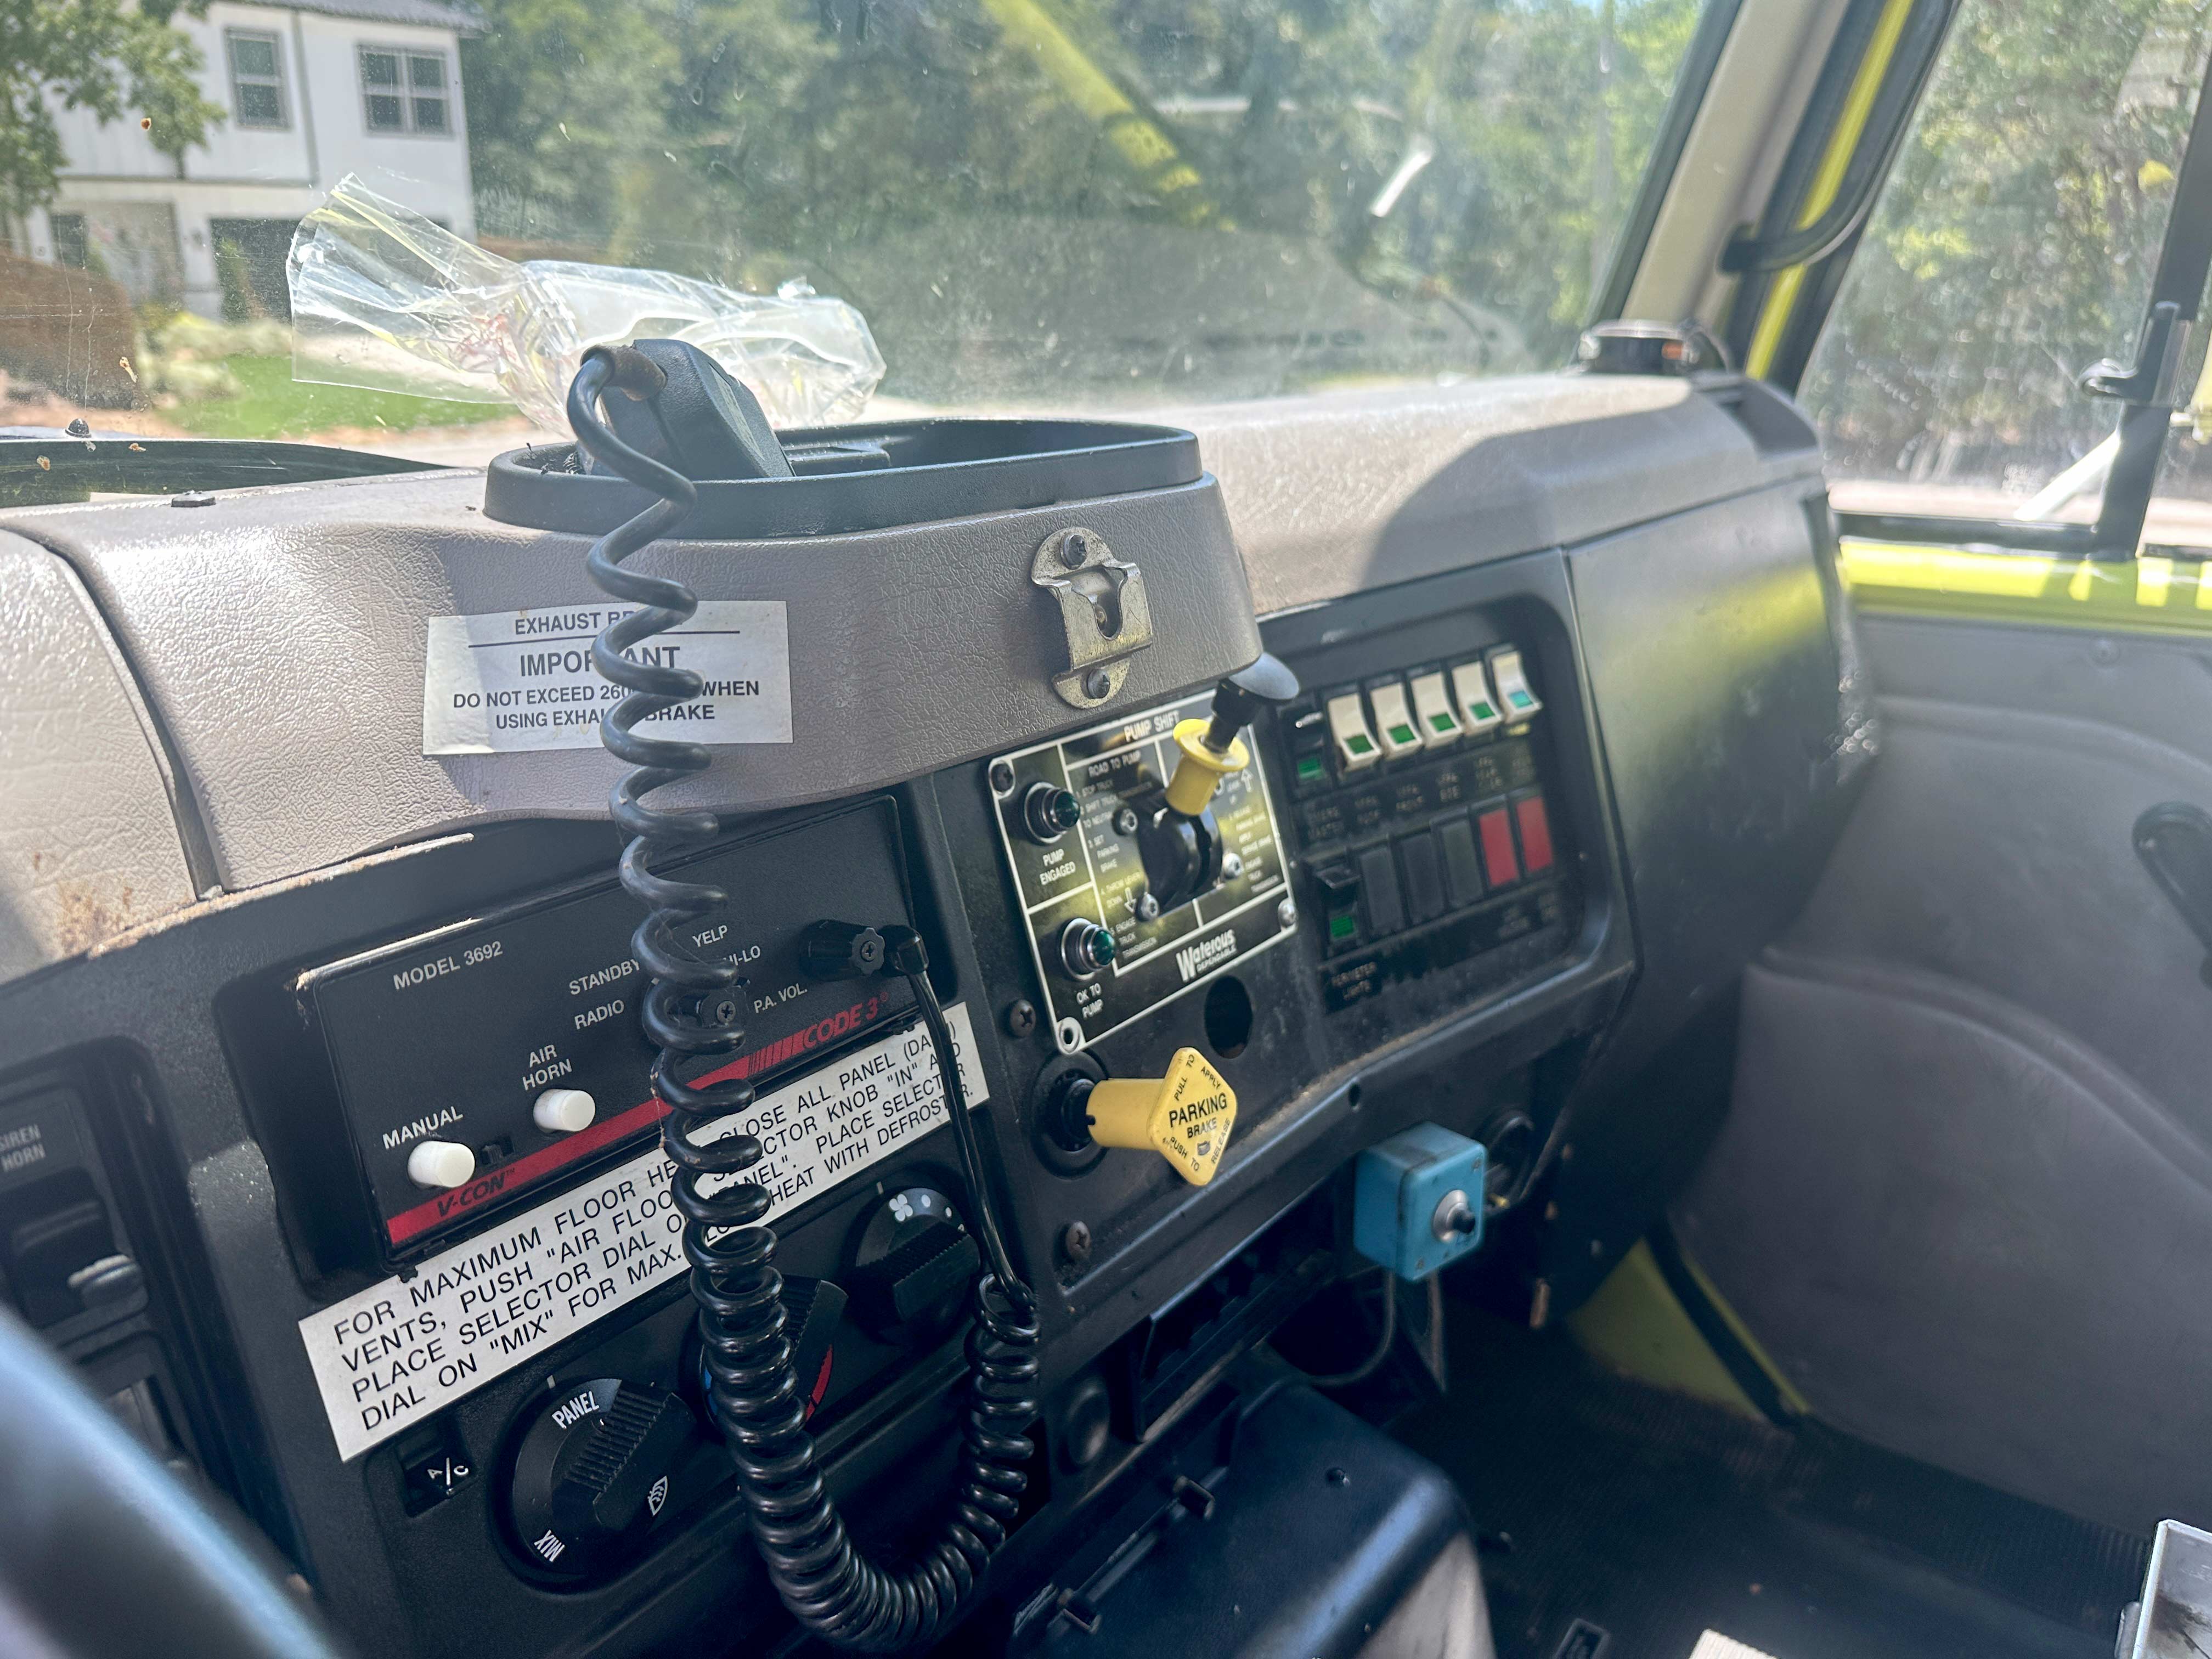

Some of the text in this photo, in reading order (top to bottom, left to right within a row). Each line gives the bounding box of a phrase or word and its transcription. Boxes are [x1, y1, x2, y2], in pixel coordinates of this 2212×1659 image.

[515, 612, 601, 635] EXHAUST
[520, 646, 680, 676] IMPOANT
[453, 693, 481, 708] DO
[486, 690, 522, 707] NOT
[527, 686, 595, 704] EXCEED
[702, 681, 759, 696] WHEN
[496, 711, 548, 729] USING
[1124, 710, 1180, 742] PUMP SHIFT
[1088, 750, 1141, 777] ROAD TO PUMP
[1040, 861, 1076, 885] ENGAGED
[1042, 848, 1064, 867] PUMP
[692, 925, 729, 948] YELP
[393, 940, 504, 990] MODEL 3692
[1176, 929, 1236, 983] Waterous
[569, 958, 641, 995] STANDBY
[754, 983, 808, 1013] P.A. VOL.
[1076, 983, 1102, 1005] OK TO
[1082, 998, 1104, 1020] PUMP
[574, 999, 625, 1030] RADIO
[804, 1003, 863, 1048] CODE
[529, 1043, 558, 1068] AIR
[522, 1058, 573, 1091] HORN
[1174, 1054, 1221, 1102] PULL TO APPLY
[1169, 1092, 1228, 1128] PARKING
[382, 1105, 464, 1150] MANUAL
[1187, 1117, 1218, 1139] BRAKE
[1, 1143, 46, 1172] HORN
[1170, 1118, 1231, 1171] PUSH TO RELEASE
[334, 1299, 396, 1345] FOR
[409, 1226, 541, 1307] MAXIMUM
[554, 1180, 636, 1234] FLOOR
[797, 1085, 832, 1114] ALL
[838, 1052, 896, 1086] PANEL
[904, 1020, 956, 1062] (DA)
[341, 1311, 447, 1372] VENTS,
[460, 1261, 533, 1313] PUSH
[546, 1228, 600, 1264] "AIR
[612, 1190, 674, 1235] FLOO
[827, 1084, 878, 1123] KNOB
[887, 1062, 918, 1087] "IN"
[930, 1042, 961, 1070] AD
[352, 1338, 446, 1402] PLACE
[459, 1261, 591, 1346] SELECTOR
[602, 1230, 656, 1268] DIAL
[816, 1111, 875, 1154] PLACE
[882, 1063, 966, 1118] SELECTR
[361, 1084, 973, 1431] DIAL ON "MIX" FOR MAX. HEAT WITH DEFROSTR.
[552, 1391, 600, 1429] PANEL
[427, 1457, 469, 1486] A/C
[534, 1529, 566, 1562] MIX
